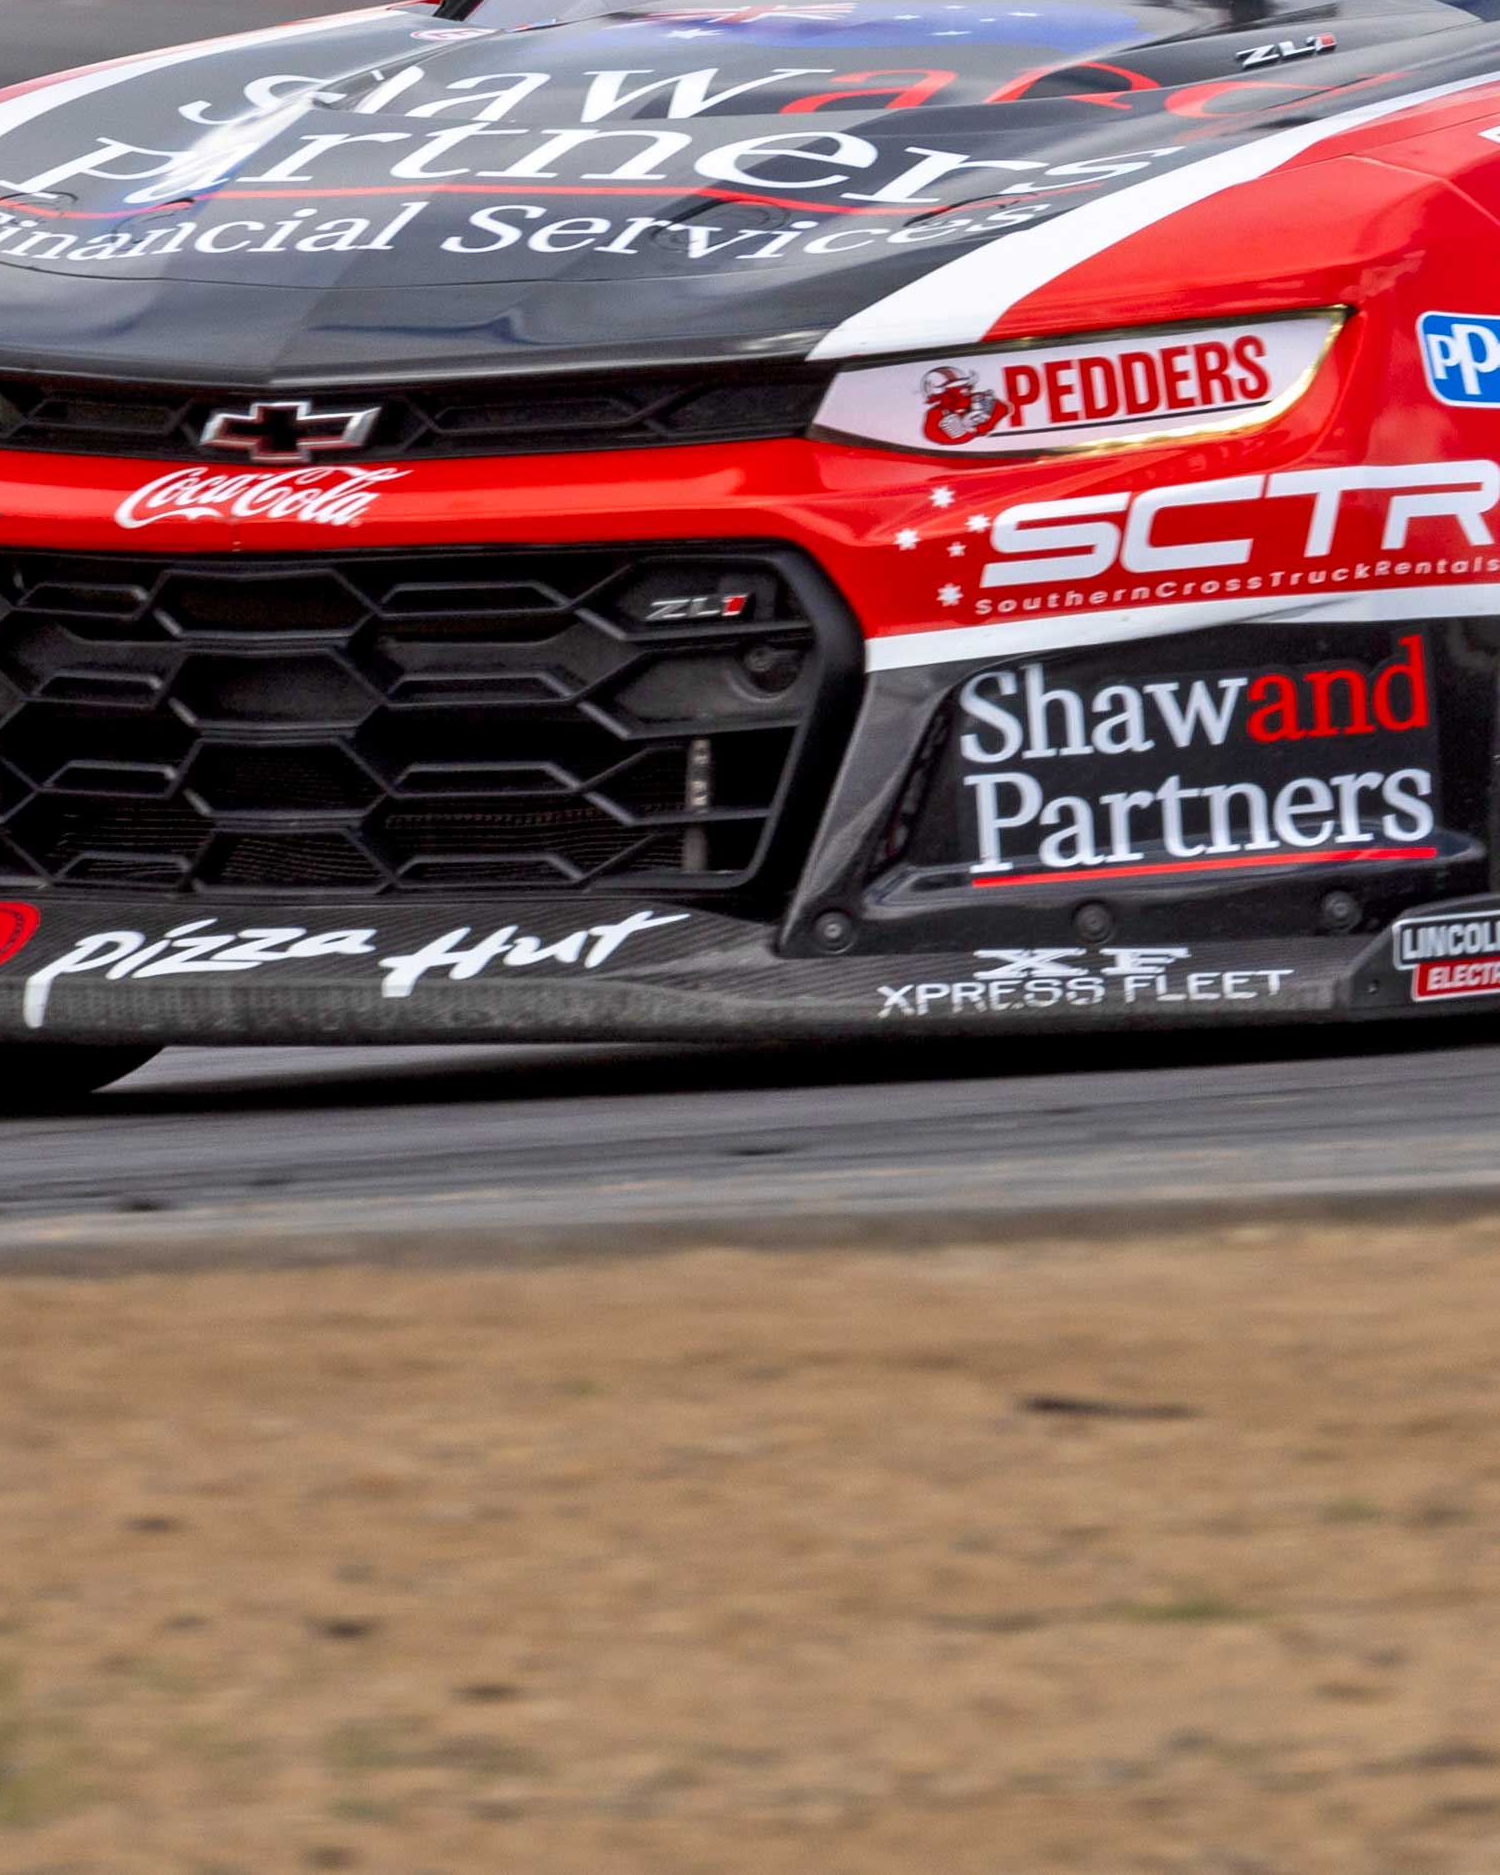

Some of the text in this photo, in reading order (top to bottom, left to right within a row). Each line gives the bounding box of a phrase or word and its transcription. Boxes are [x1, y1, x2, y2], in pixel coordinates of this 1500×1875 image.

[439, 201, 1054, 259] Services
[1002, 334, 1269, 429] PEDDERS
[975, 556, 1500, 616] SouthernCrossTruckRentals
[963, 765, 1435, 876] Partners
[378, 910, 690, 998] Hut
[877, 969, 1294, 1018] XPRESS FLEET
